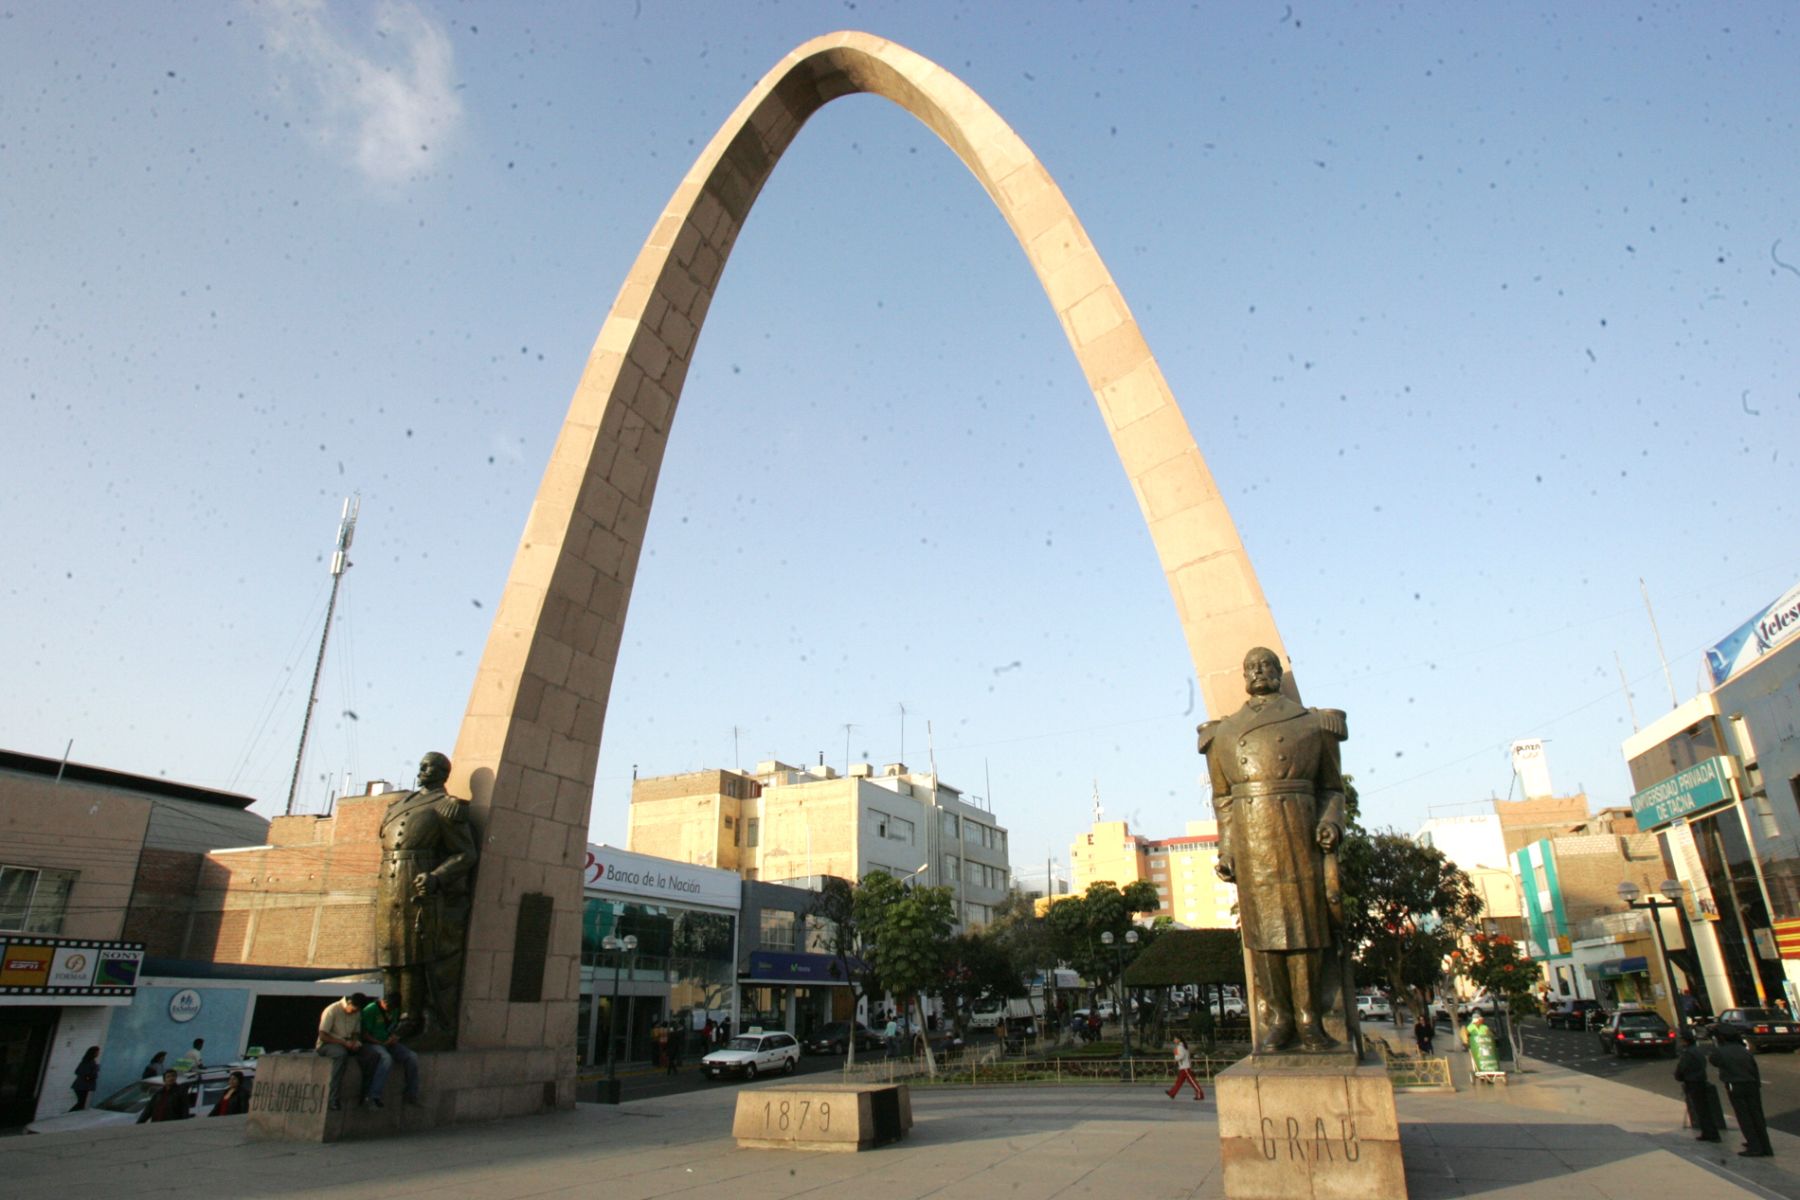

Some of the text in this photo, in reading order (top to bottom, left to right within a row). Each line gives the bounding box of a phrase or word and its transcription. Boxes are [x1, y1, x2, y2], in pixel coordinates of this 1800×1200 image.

[1632, 763, 1716, 813] UNIVERSIDAD PRIVADA
[1656, 792, 1695, 820] DE TACNA
[606, 864, 700, 894] Banco de la Nación
[102, 951, 141, 961] SONY
[252, 1081, 326, 1114] BOLOGNESI
[764, 1101, 830, 1132] 1879
[1260, 1117, 1359, 1162] GRAU
